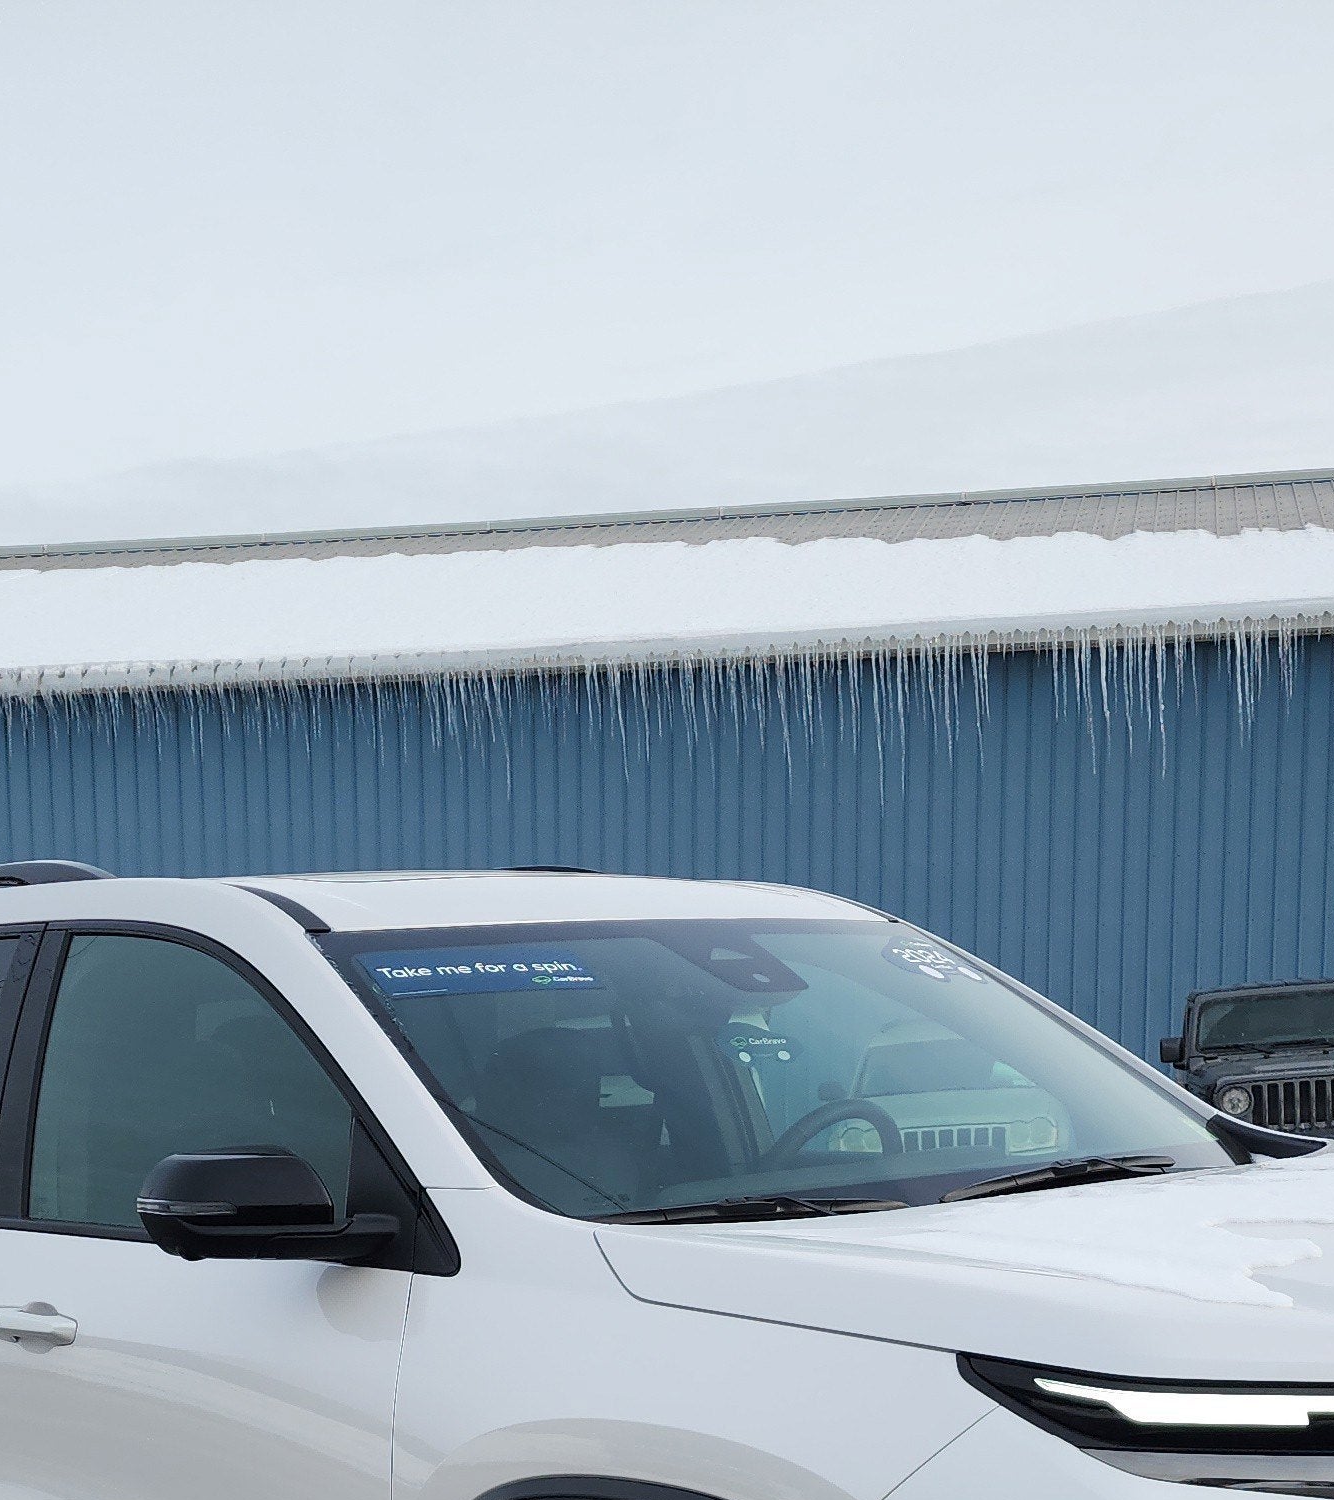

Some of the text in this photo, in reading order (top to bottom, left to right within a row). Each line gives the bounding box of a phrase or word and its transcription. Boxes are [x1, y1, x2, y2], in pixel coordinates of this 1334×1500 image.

[376, 966, 433, 980] Take
[435, 963, 473, 976] me
[474, 962, 507, 974] for
[512, 962, 529, 973] a
[748, 1037, 787, 1045] CarBravo
